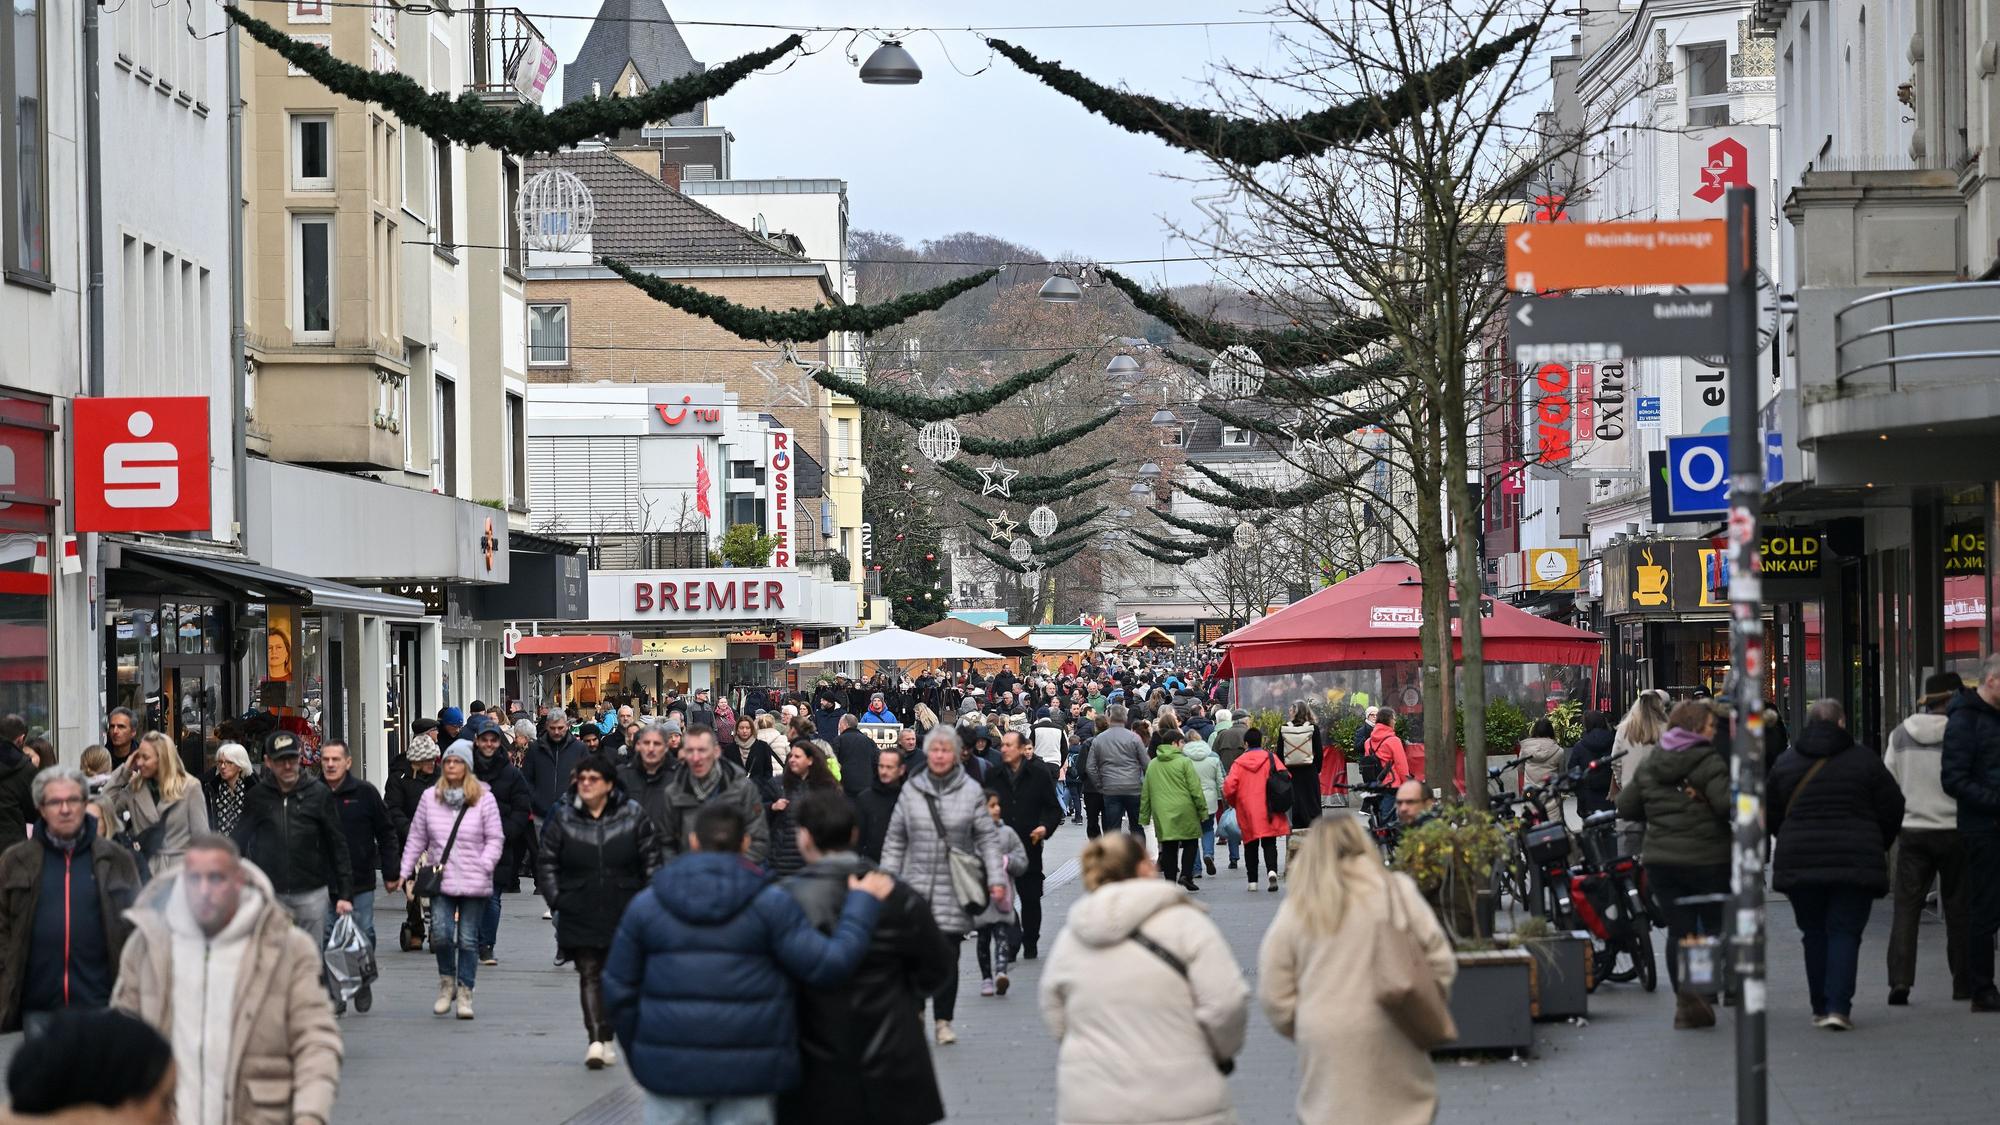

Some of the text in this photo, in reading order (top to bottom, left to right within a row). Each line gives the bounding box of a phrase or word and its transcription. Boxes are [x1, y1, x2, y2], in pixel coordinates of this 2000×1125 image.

[1653, 303, 1713, 318] Bahnhof
[694, 409, 720, 422] TUI
[772, 432, 791, 568] RÖSELER
[635, 581, 785, 612] BREMER
